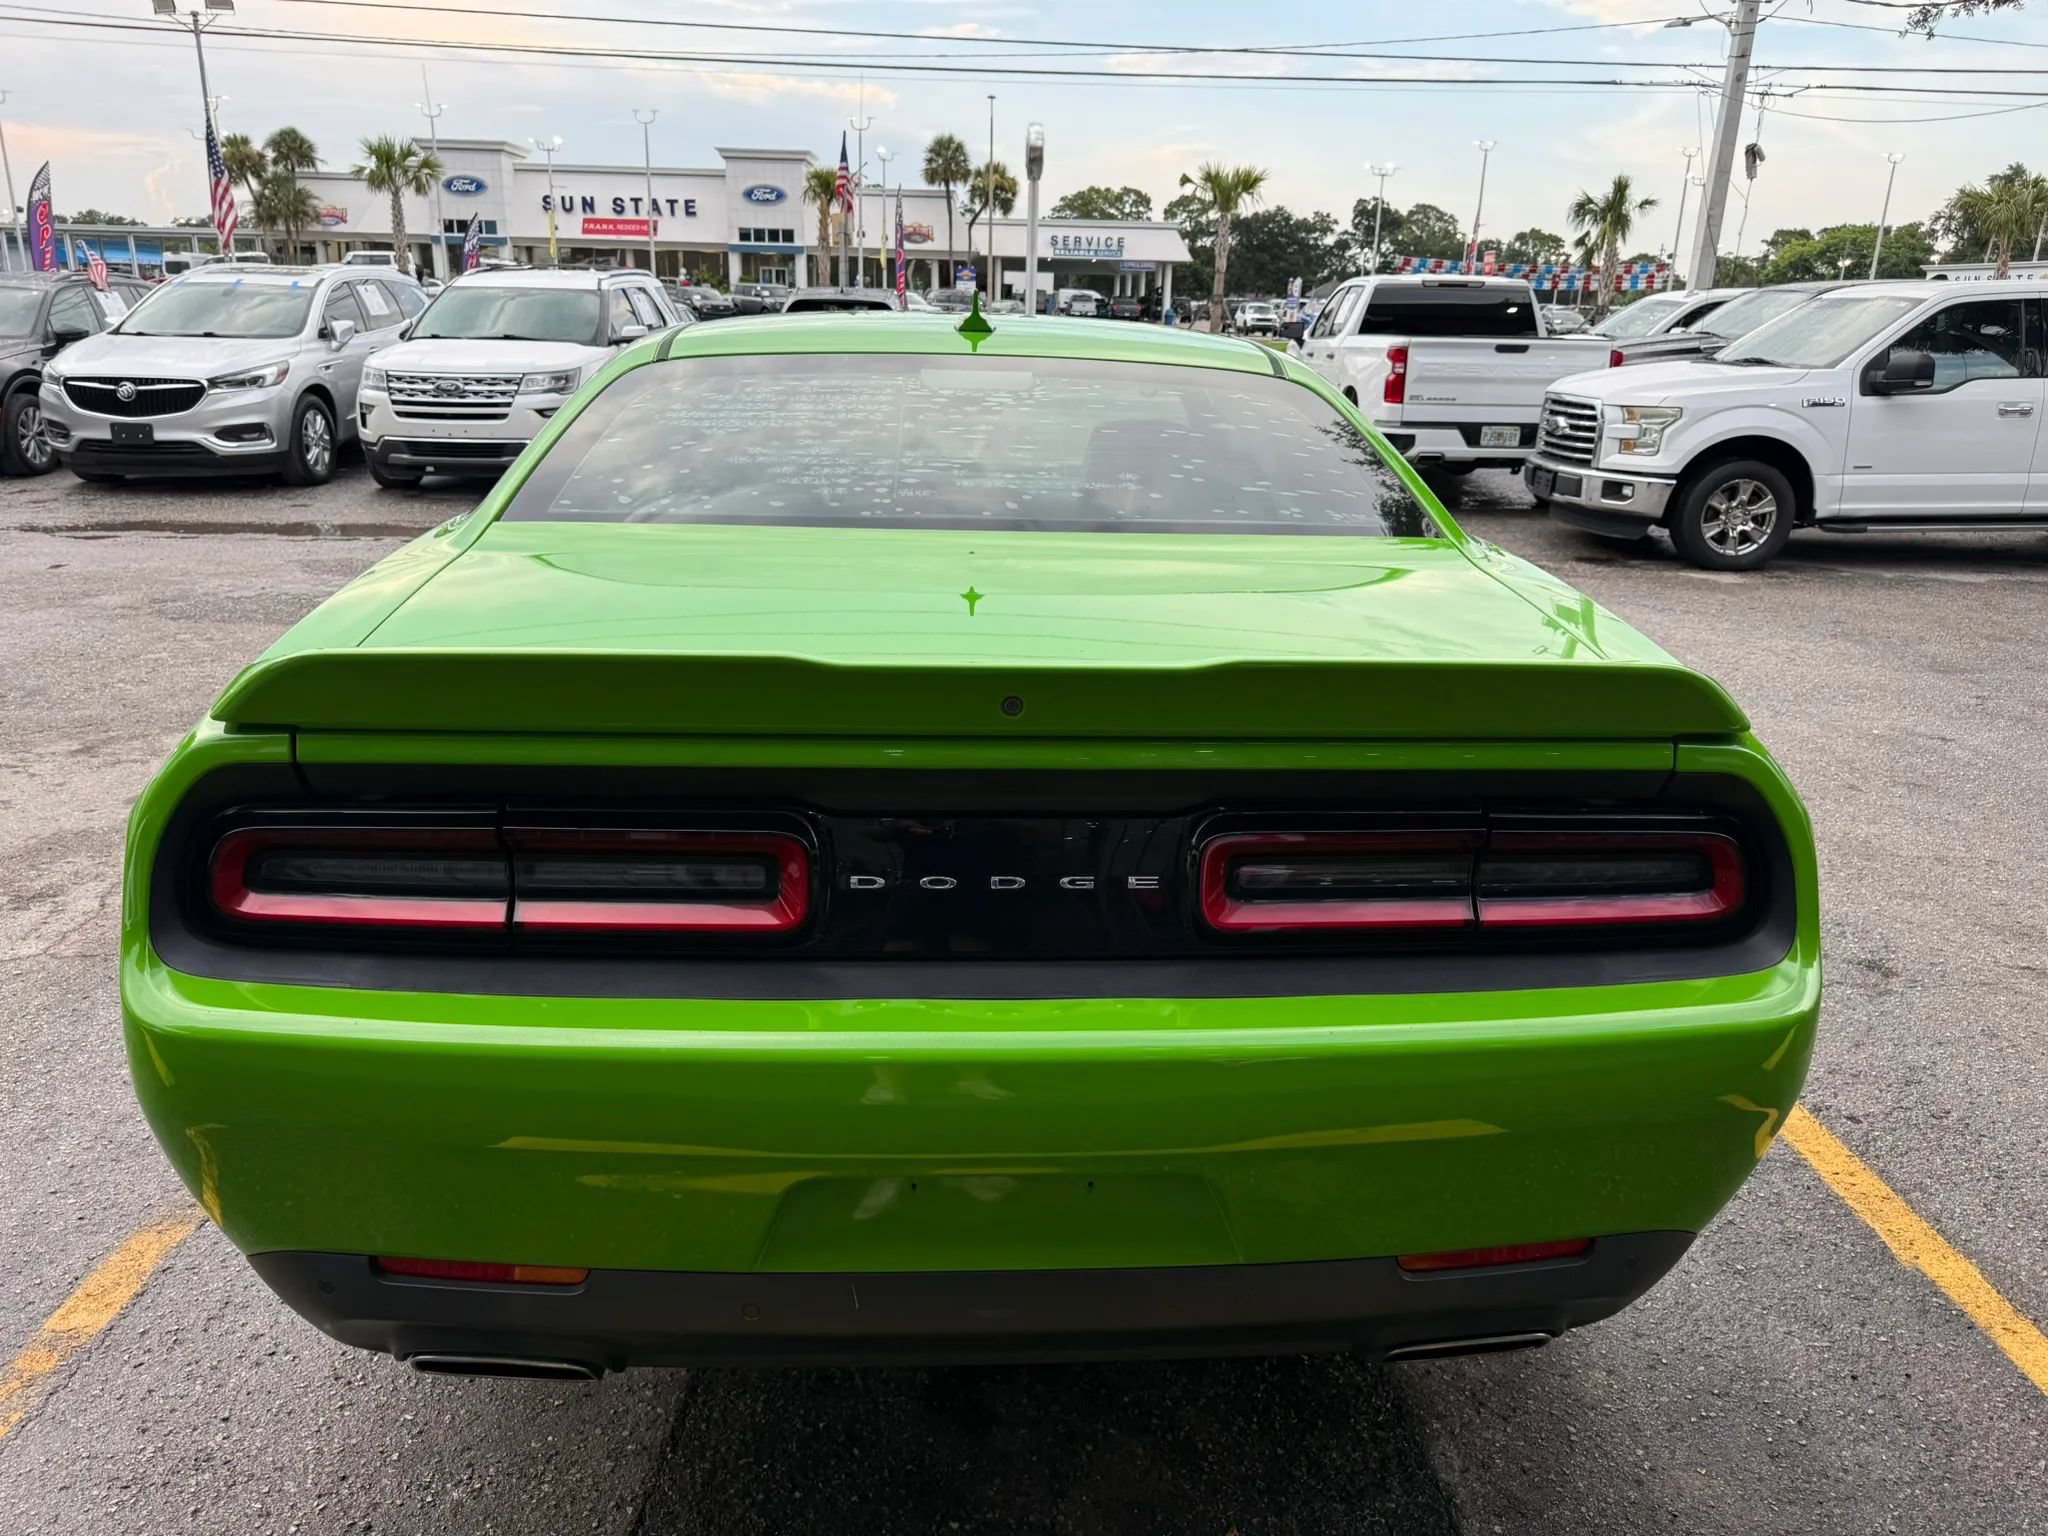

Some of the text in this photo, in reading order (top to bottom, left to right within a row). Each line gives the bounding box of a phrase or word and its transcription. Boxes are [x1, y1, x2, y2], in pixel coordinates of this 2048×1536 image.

[451, 179, 477, 191] Ford
[752, 188, 777, 200] Ford
[542, 195, 697, 217] SUN STATE
[1050, 235, 1125, 248] SERVICE
[850, 875, 1160, 890] DODGE
